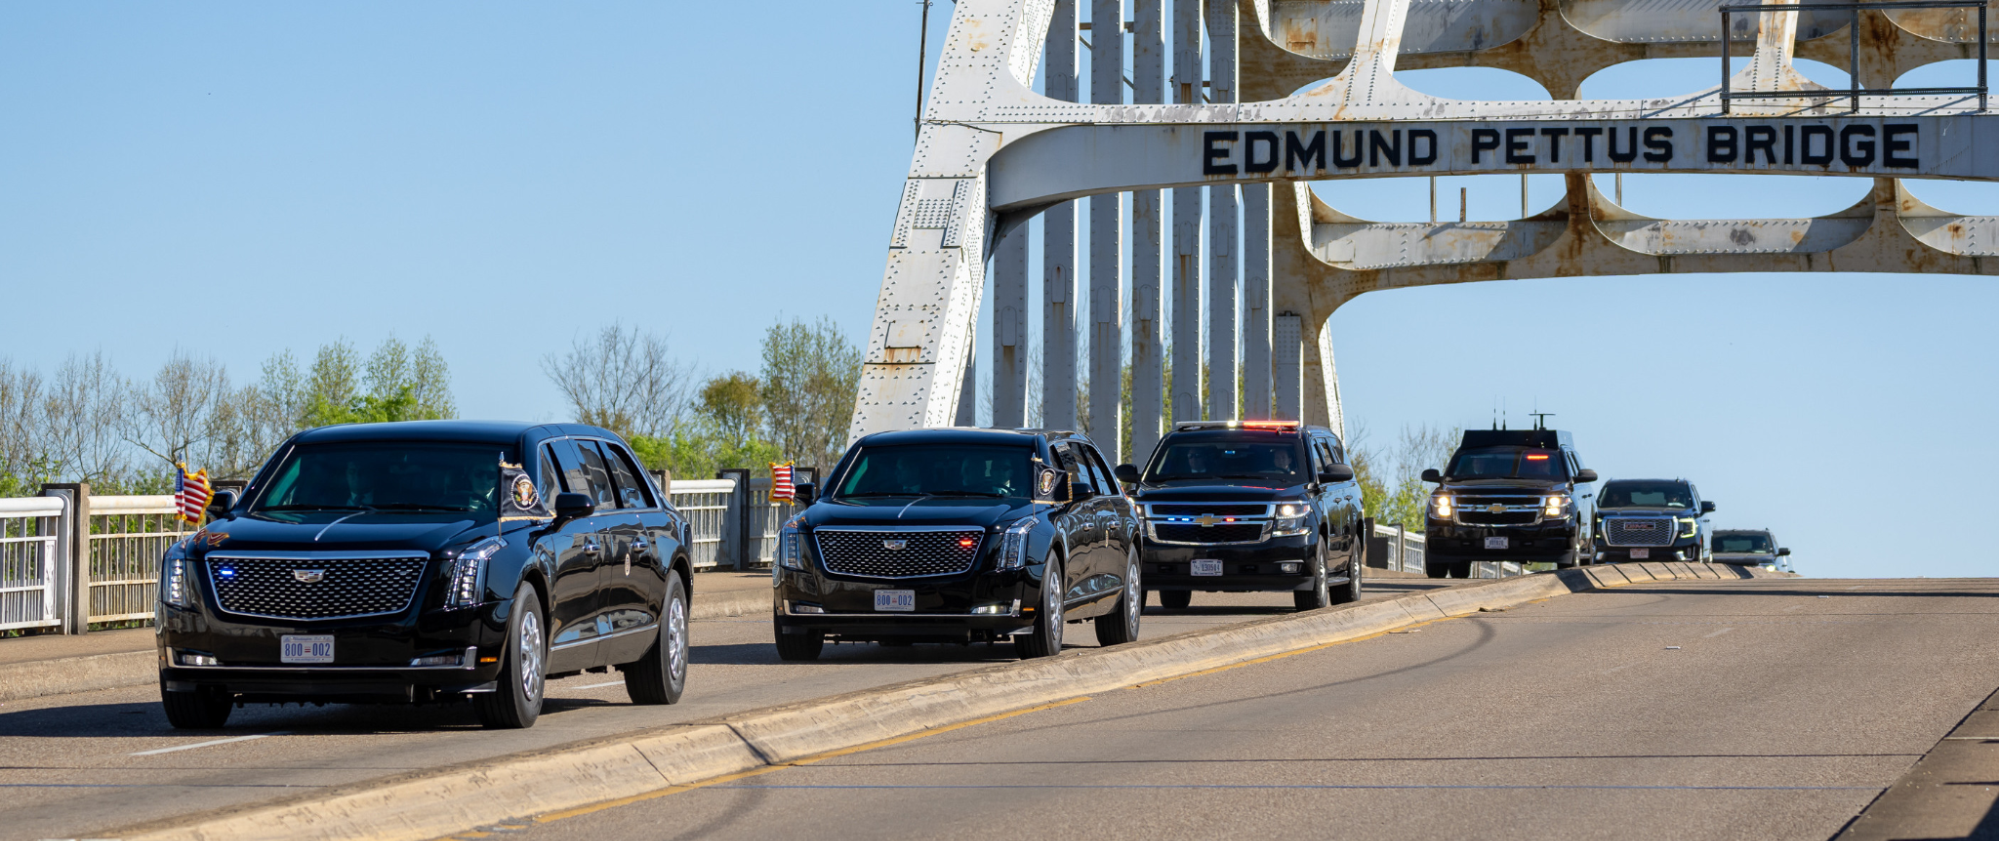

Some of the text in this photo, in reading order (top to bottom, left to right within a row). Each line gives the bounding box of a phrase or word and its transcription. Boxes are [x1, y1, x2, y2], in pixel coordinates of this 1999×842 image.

[1203, 124, 1919, 174] EDMUND PETTUS BRIDGE
[285, 642, 330, 657] 800 002
